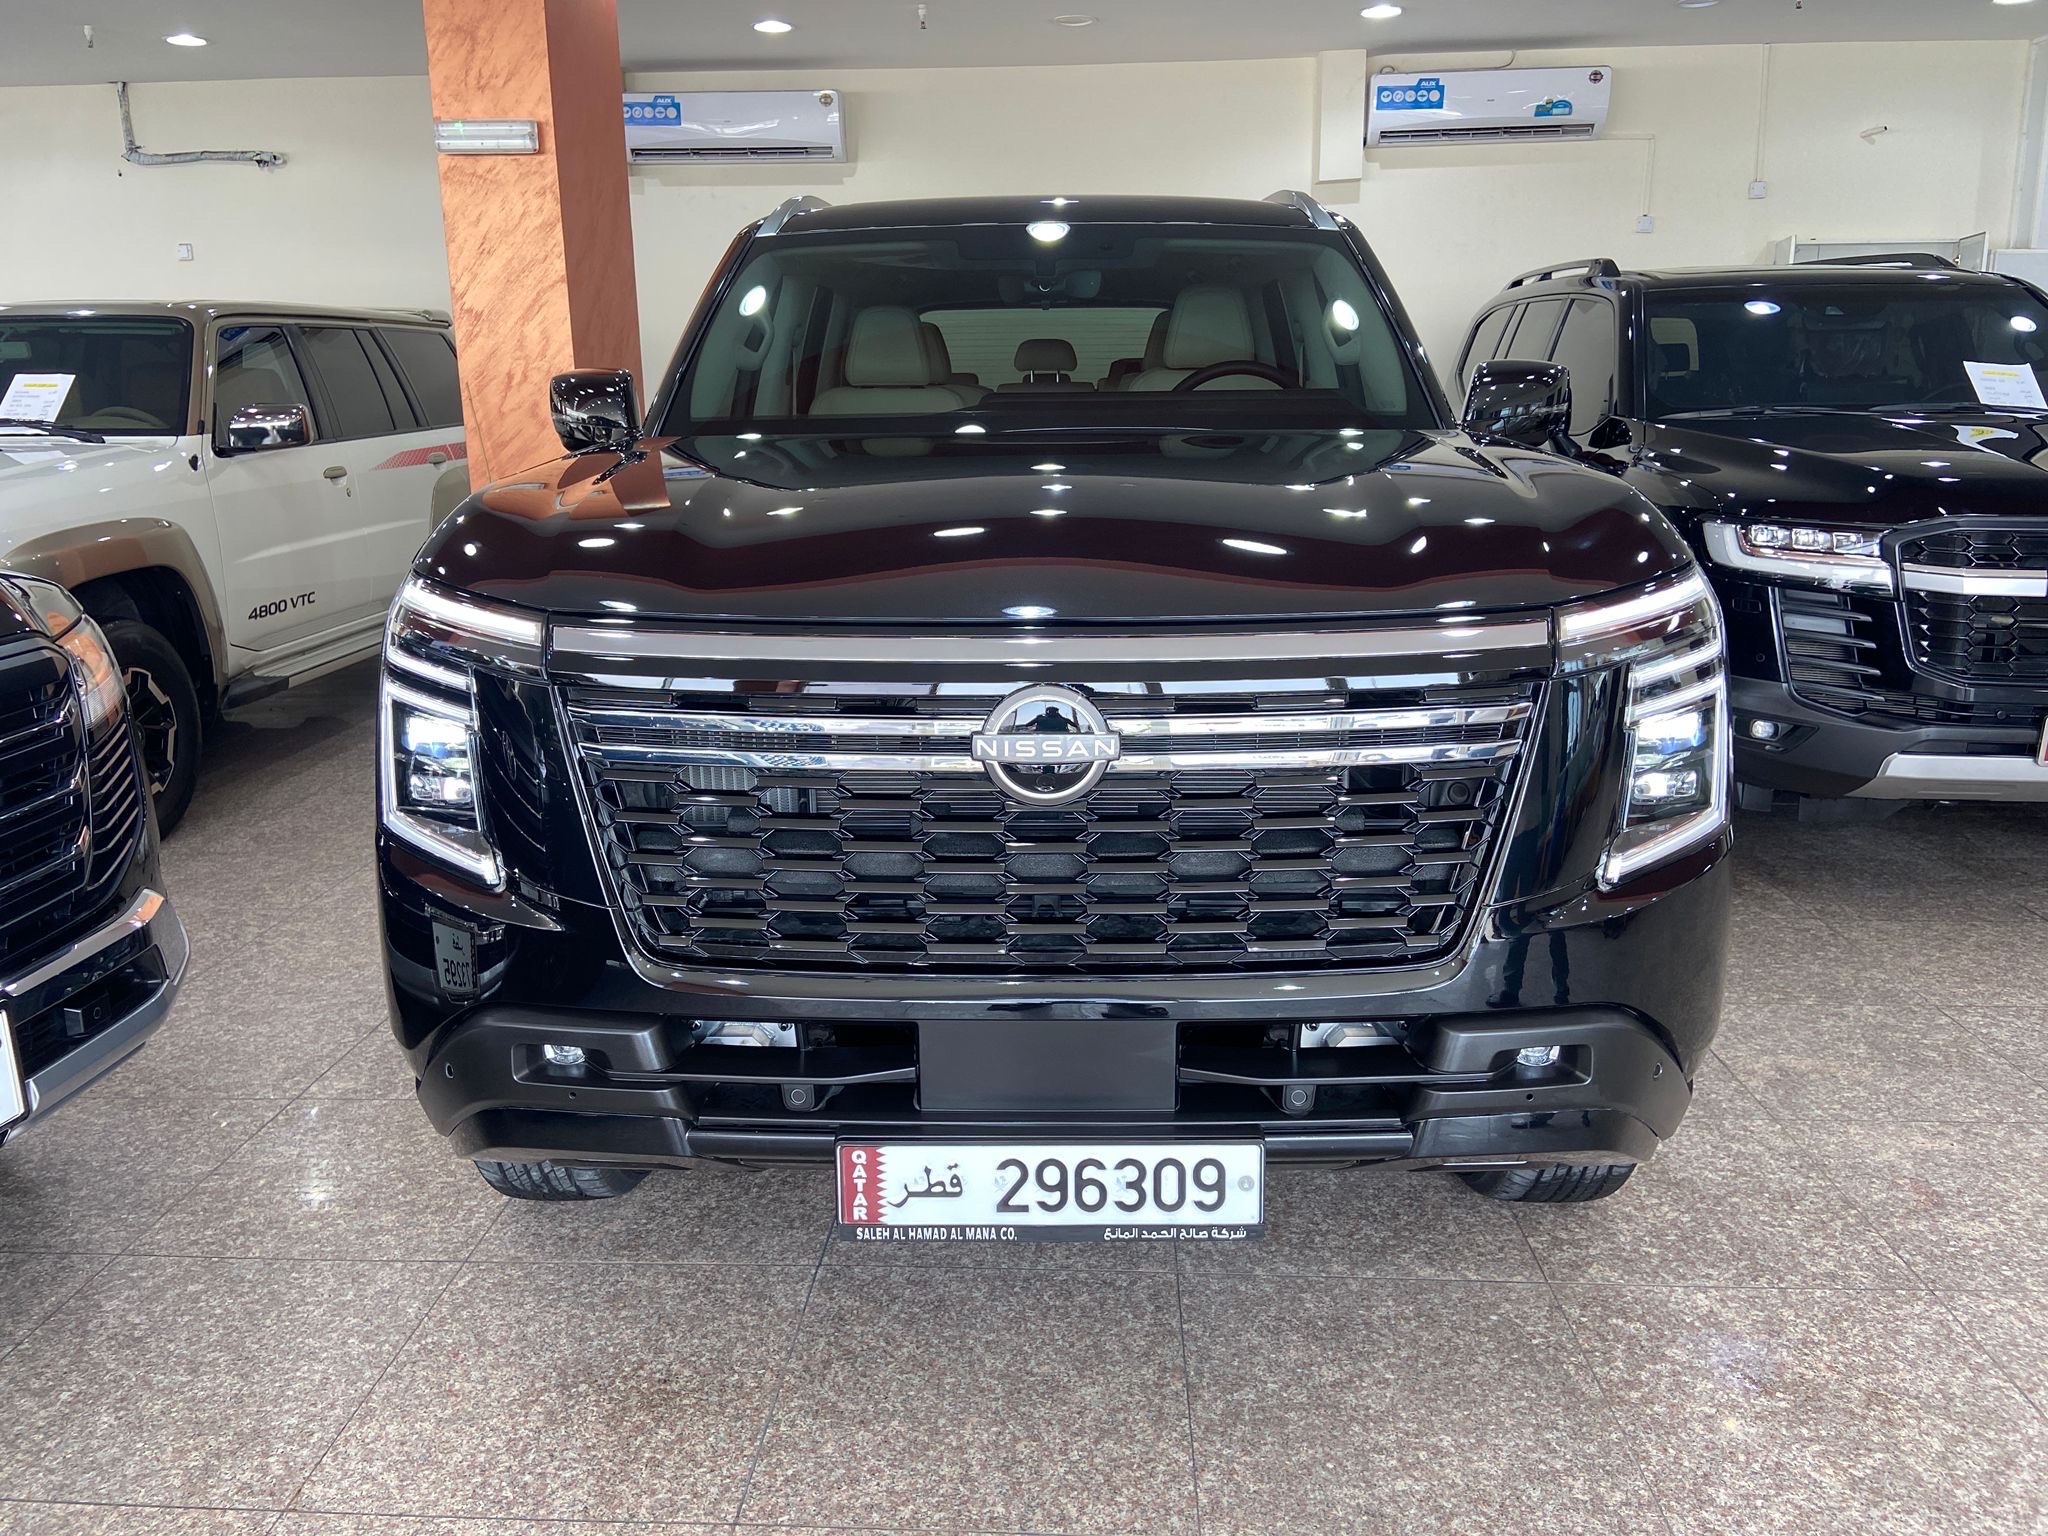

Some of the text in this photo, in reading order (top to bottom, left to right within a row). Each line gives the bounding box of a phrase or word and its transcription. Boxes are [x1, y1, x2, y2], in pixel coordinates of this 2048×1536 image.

[248, 591, 315, 620] 4800 VTC
[976, 738, 1115, 758] NISSAN
[851, 1149, 868, 1221] QATAR
[887, 1162, 963, 1208] قطر
[996, 1157, 1226, 1213] 296309
[856, 1226, 1018, 1241] SALEH AL HAMAD AL MANA CO.
[1103, 1226, 1247, 1240] شركة صالح الحمد المانع
